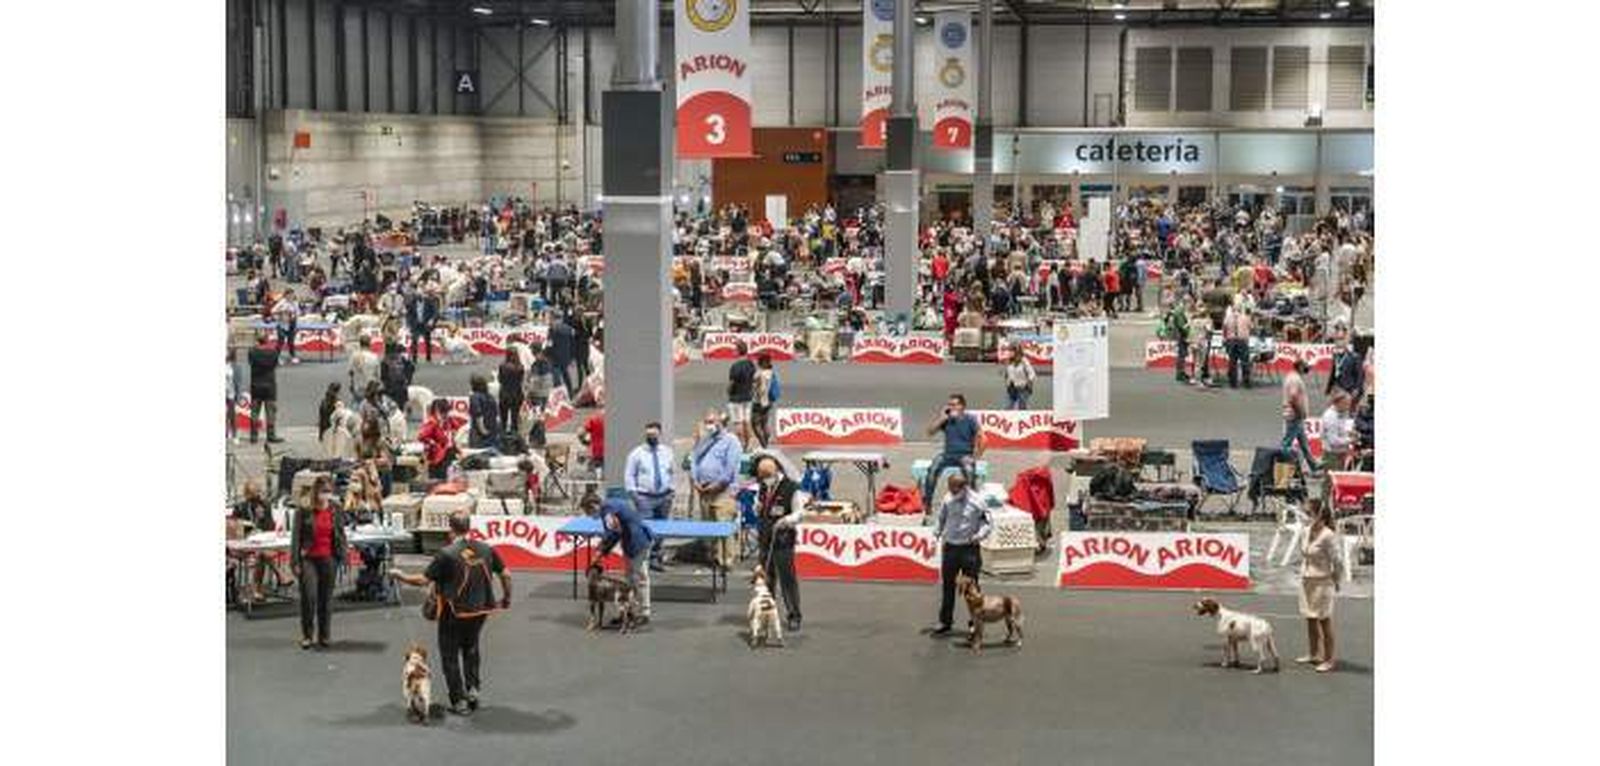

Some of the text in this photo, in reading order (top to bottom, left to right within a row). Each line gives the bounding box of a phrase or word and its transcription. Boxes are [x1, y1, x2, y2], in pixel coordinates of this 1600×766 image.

[681, 54, 746, 80] ARION
[457, 73, 474, 92] A
[705, 114, 725, 144] 3
[948, 127, 959, 143] 7
[1075, 138, 1199, 162] cafeteria
[750, 335, 791, 349] ARION
[900, 338, 941, 354] ARION
[779, 412, 899, 432] ARION ARION
[981, 413, 1013, 434] ION
[469, 520, 548, 549] ARION
[797, 528, 936, 560] ION ARION
[1064, 536, 1243, 568] ARION ARION
